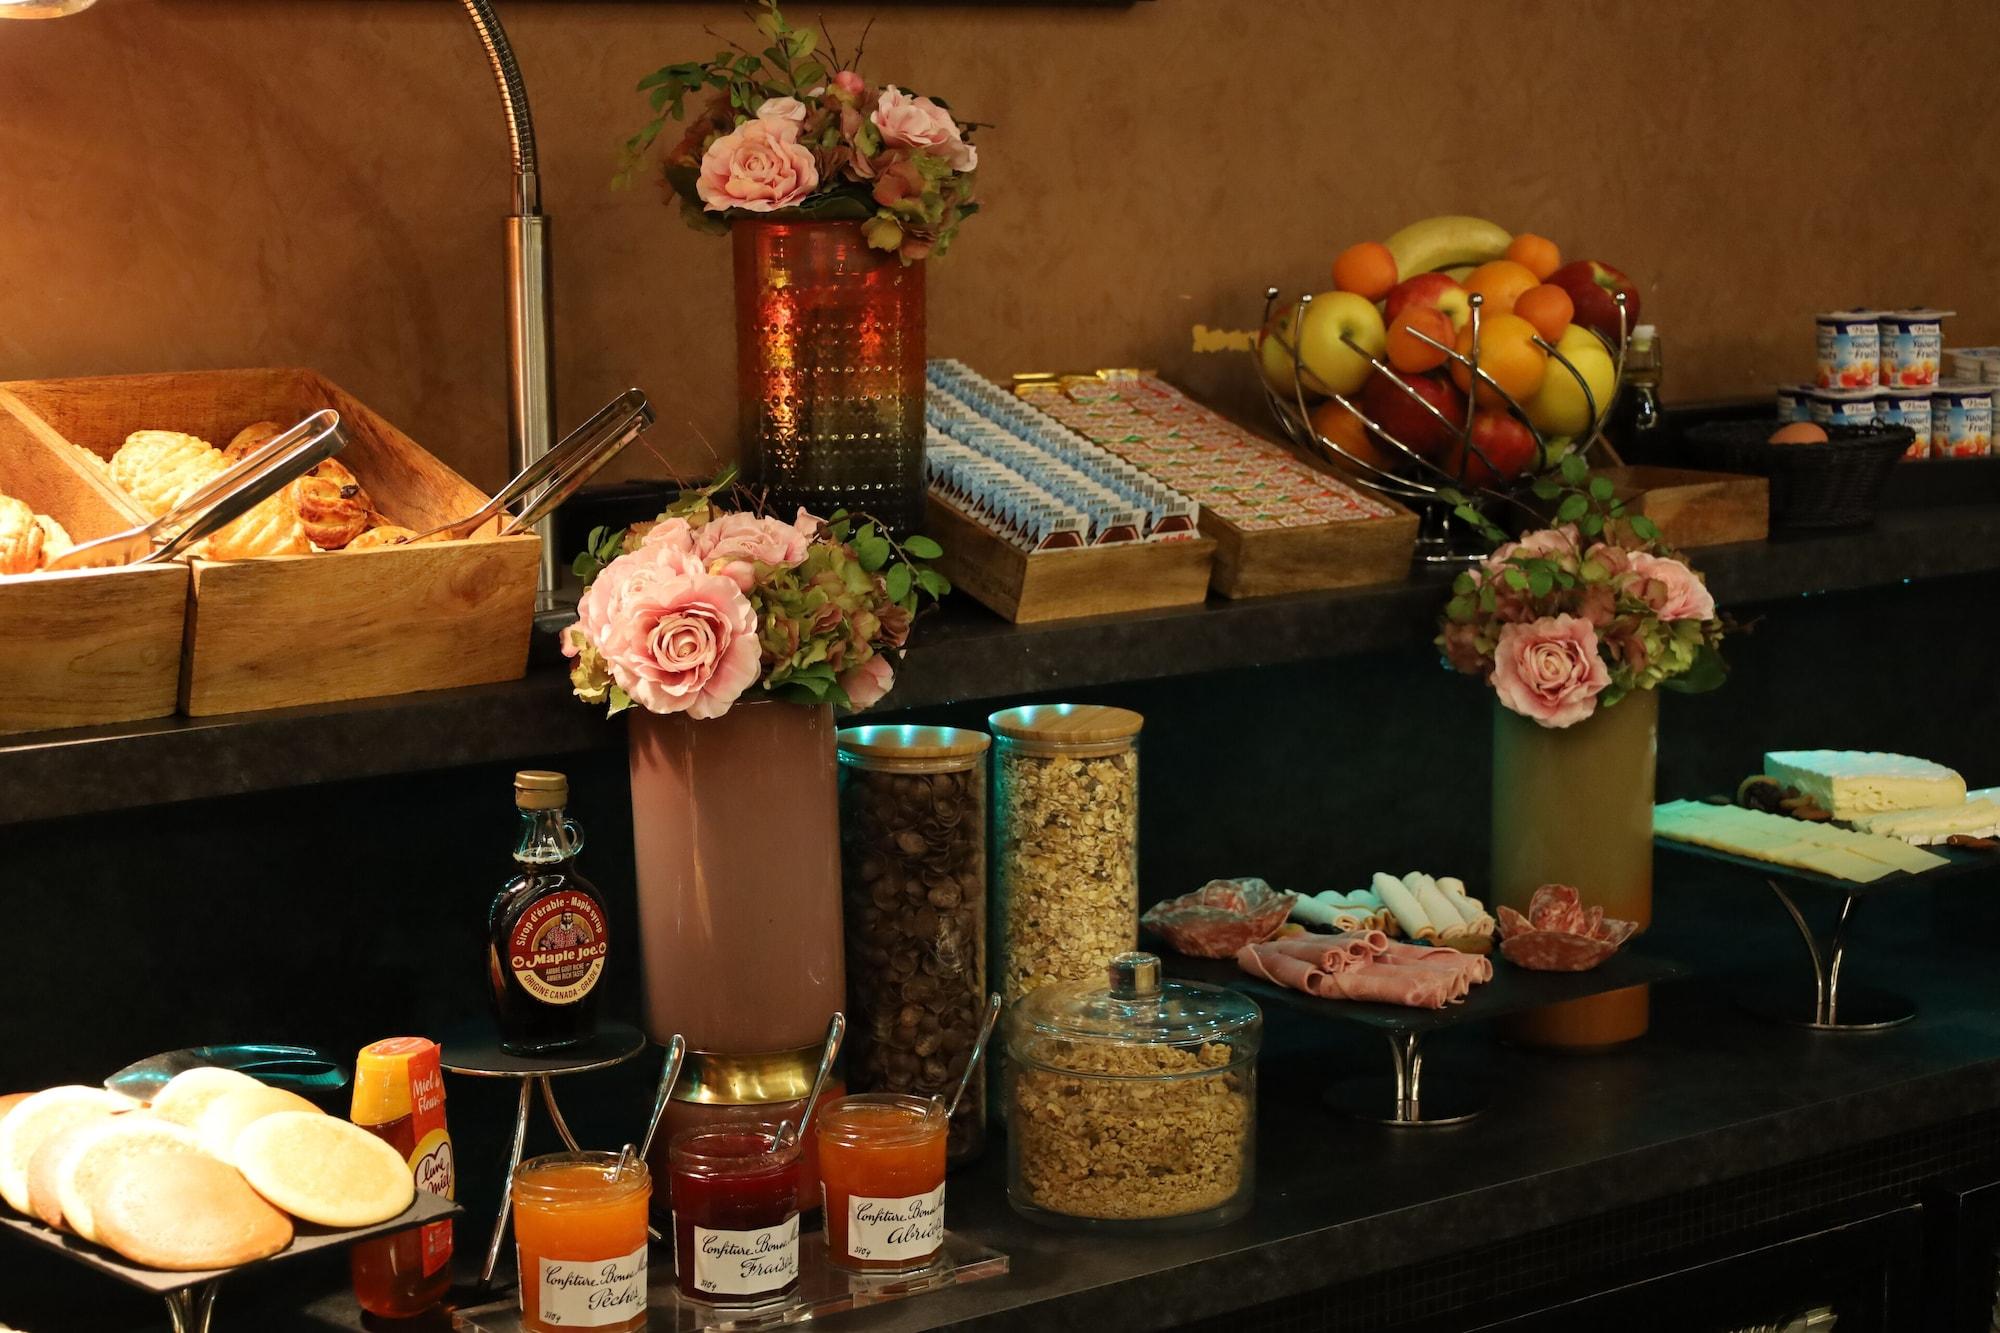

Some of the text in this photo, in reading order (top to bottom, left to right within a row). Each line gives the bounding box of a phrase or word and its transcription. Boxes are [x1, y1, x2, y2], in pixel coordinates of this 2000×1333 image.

[516, 896, 603, 946] Sirop d'érable Maple syrup
[525, 949, 575, 968] Maple
[523, 974, 550, 998] ORIGINE
[549, 990, 578, 1000] CANADA
[580, 971, 598, 992] GRADE
[412, 1070, 434, 1099] Miel
[856, 1202, 907, 1226] Confiture
[702, 1234, 754, 1259] Confiture
[545, 1265, 599, 1290] Confiture
